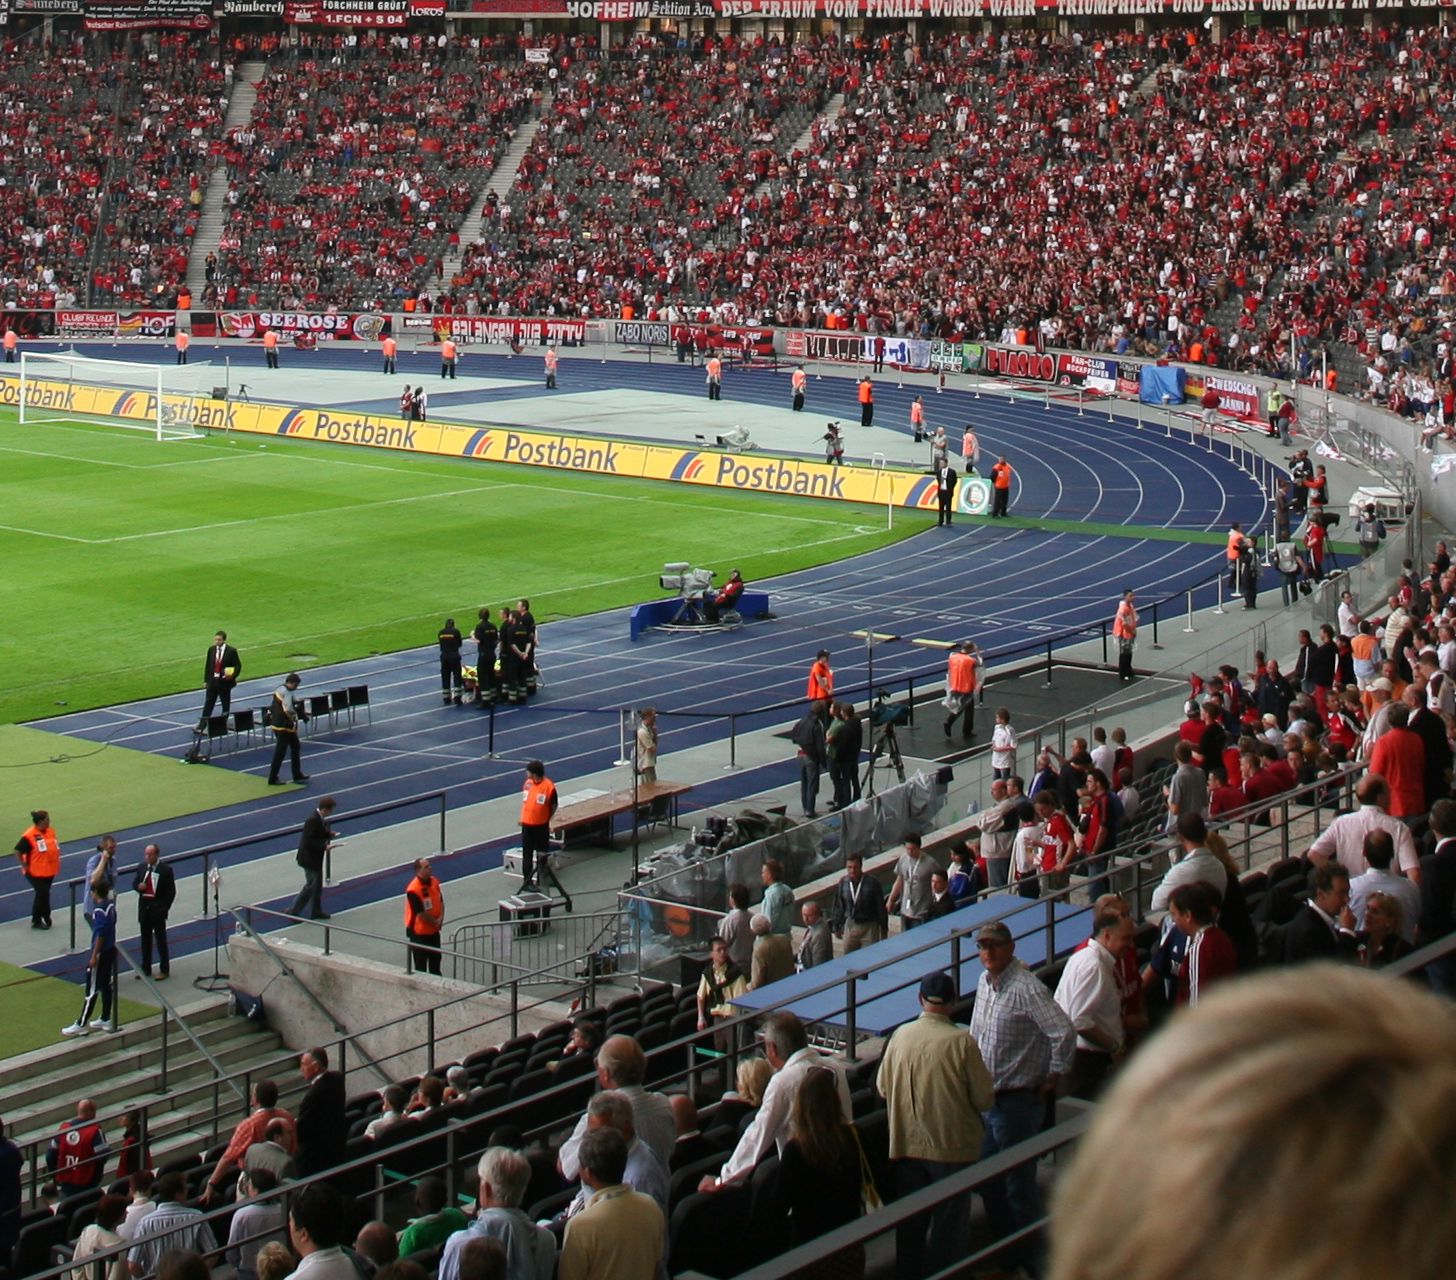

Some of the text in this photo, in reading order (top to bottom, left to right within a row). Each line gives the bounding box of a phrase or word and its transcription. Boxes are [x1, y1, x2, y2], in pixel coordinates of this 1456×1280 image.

[323, 0, 375, 11] FORCHHEIM
[567, 0, 649, 19] HOFHEIM
[759, 0, 816, 18] TRAUM
[824, 0, 859, 18] VOM
[865, 0, 923, 18] FINALE
[259, 312, 348, 330] SEEROSE
[616, 323, 640, 341] ZABO
[642, 324, 668, 344] NORIS
[313, 410, 418, 449] Postbank
[504, 431, 620, 473] Postbank
[715, 454, 846, 498] Postbank
